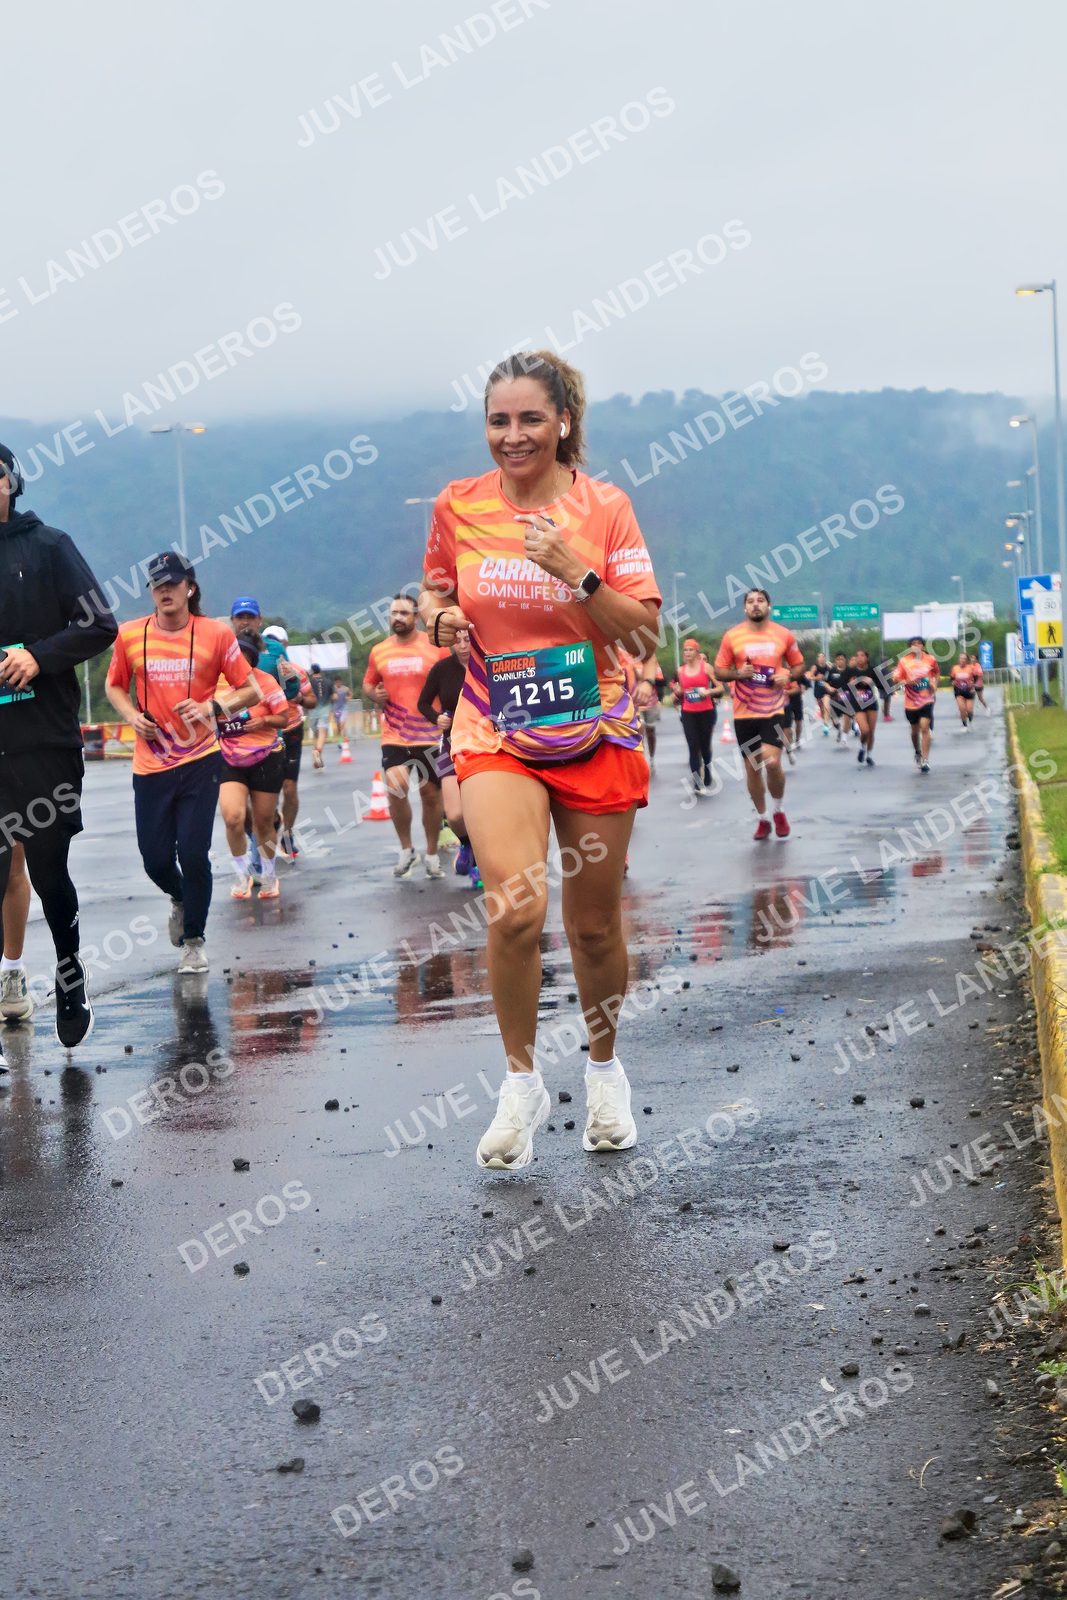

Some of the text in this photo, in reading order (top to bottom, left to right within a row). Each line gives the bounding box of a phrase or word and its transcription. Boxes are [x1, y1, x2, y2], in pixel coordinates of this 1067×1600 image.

[476, 581, 551, 601] OMNILIFE
[492, 648, 584, 673] CARRERA 10K
[510, 678, 575, 706] 1215
[224, 722, 242, 731] 212
